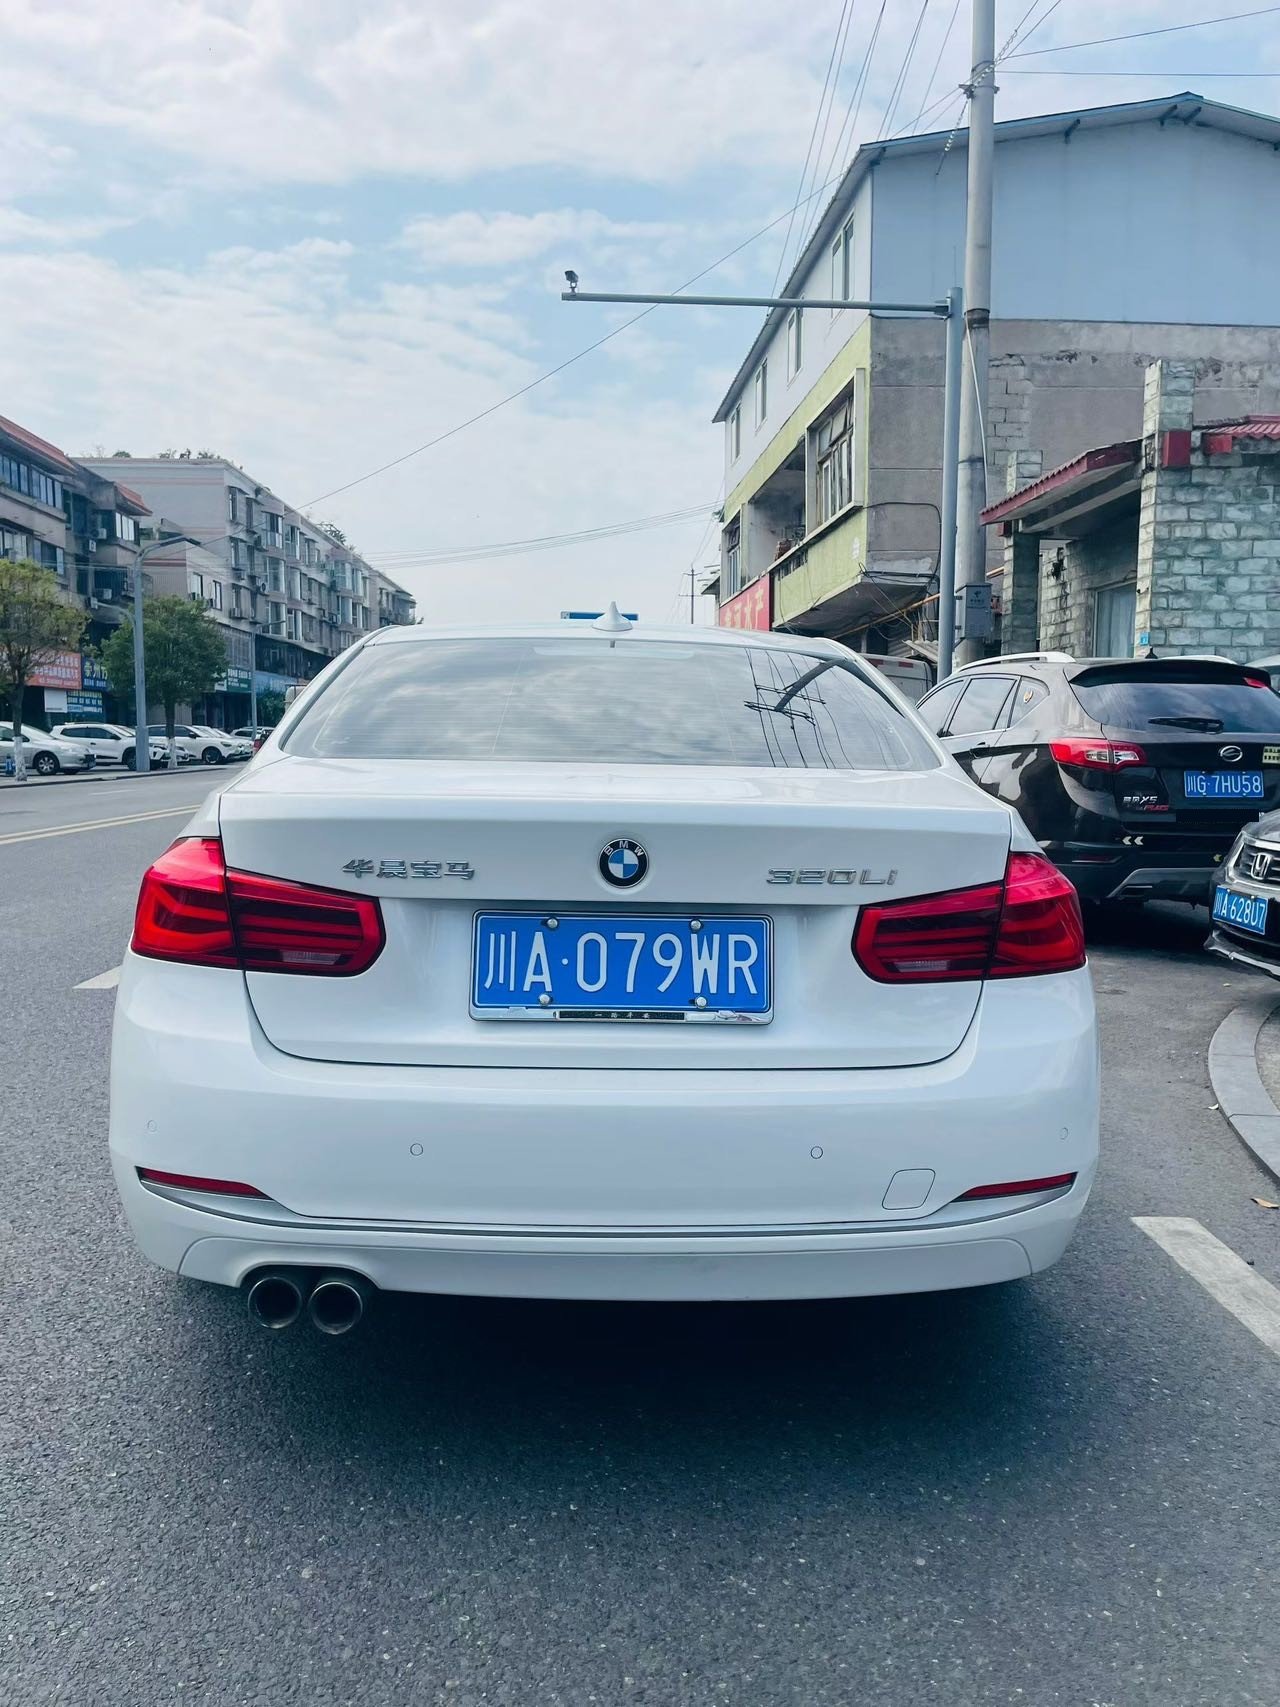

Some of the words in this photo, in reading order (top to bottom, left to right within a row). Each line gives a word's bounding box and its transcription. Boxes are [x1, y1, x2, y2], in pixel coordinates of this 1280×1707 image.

[603, 840, 645, 857] BMW
[342, 859, 475, 880] 华晨宝马
